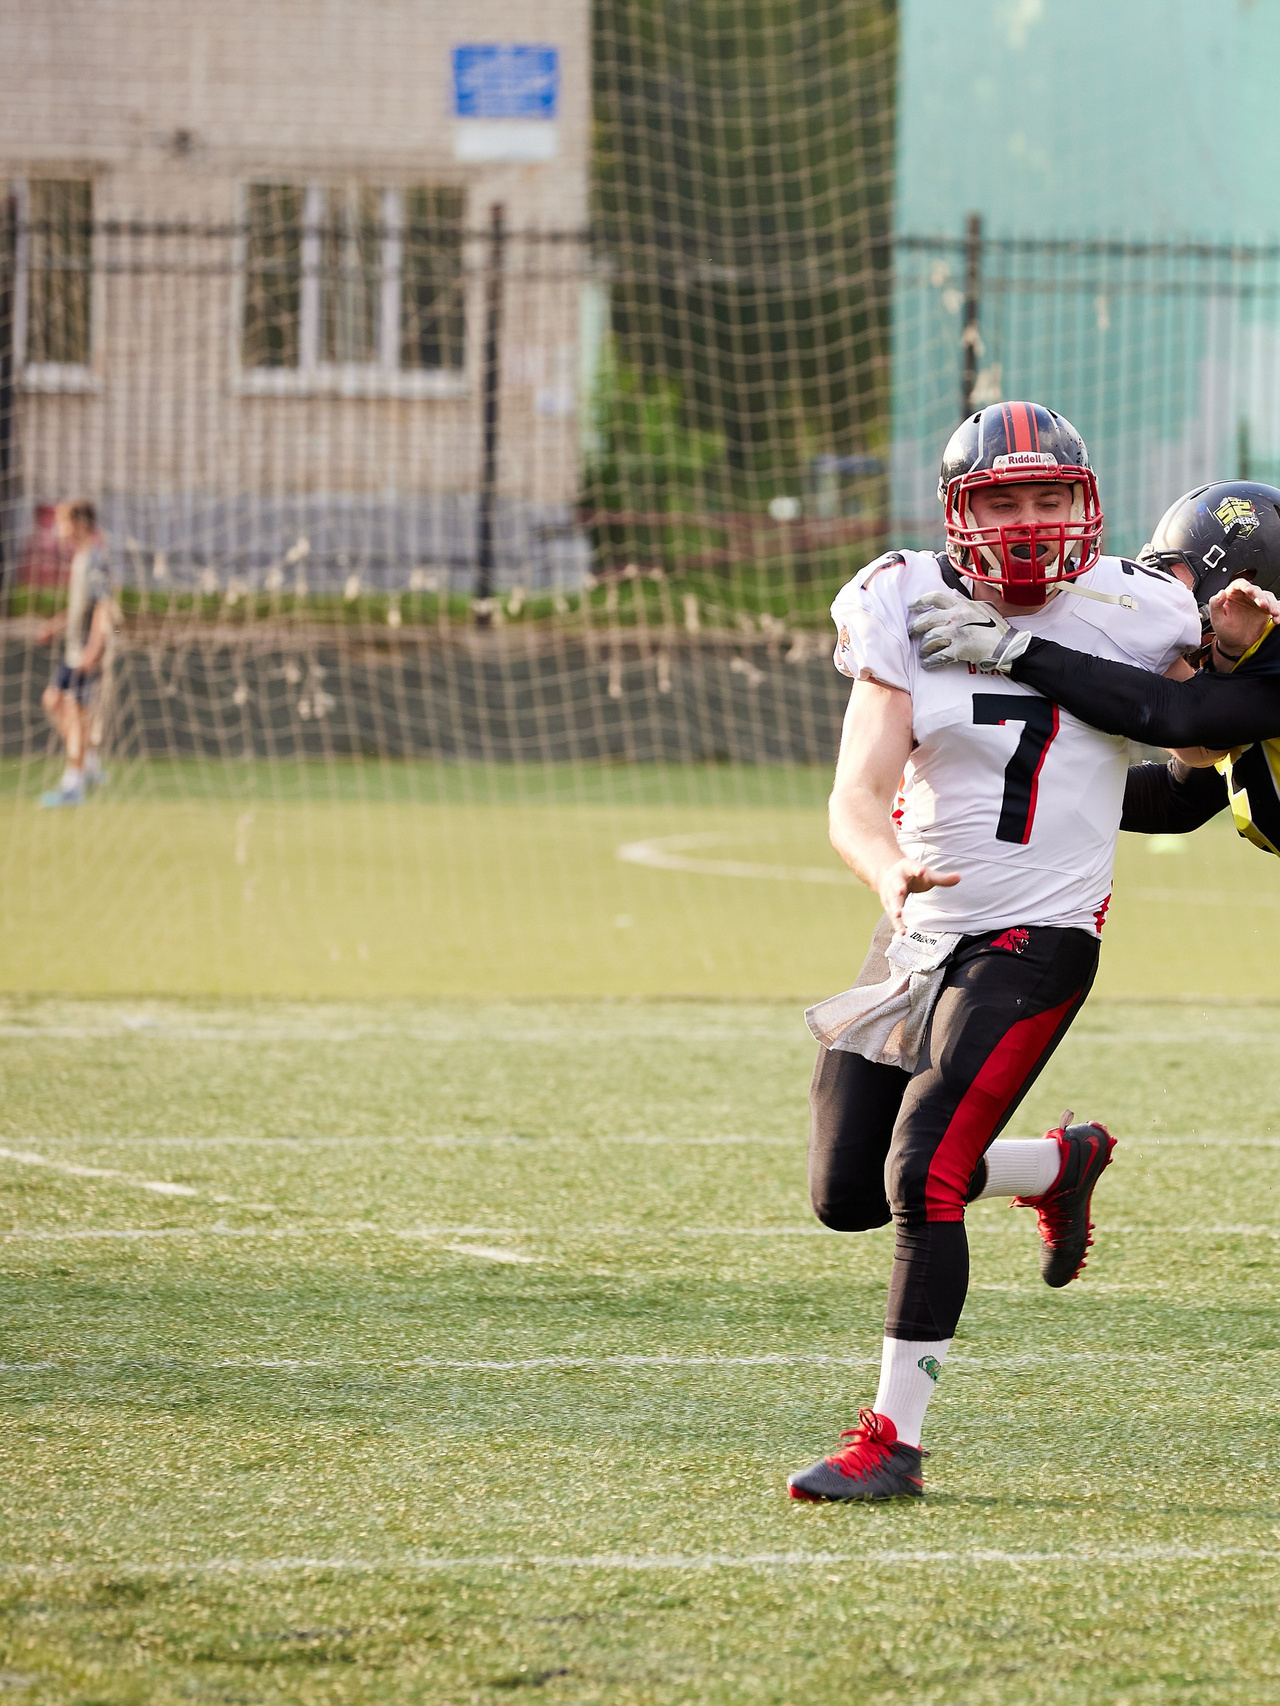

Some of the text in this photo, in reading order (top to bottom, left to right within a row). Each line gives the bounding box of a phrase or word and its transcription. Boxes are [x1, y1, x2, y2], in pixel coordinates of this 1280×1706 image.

[1008, 454, 1042, 465] Riddell
[972, 692, 1060, 845] 7
[909, 931, 938, 946] Wilson
